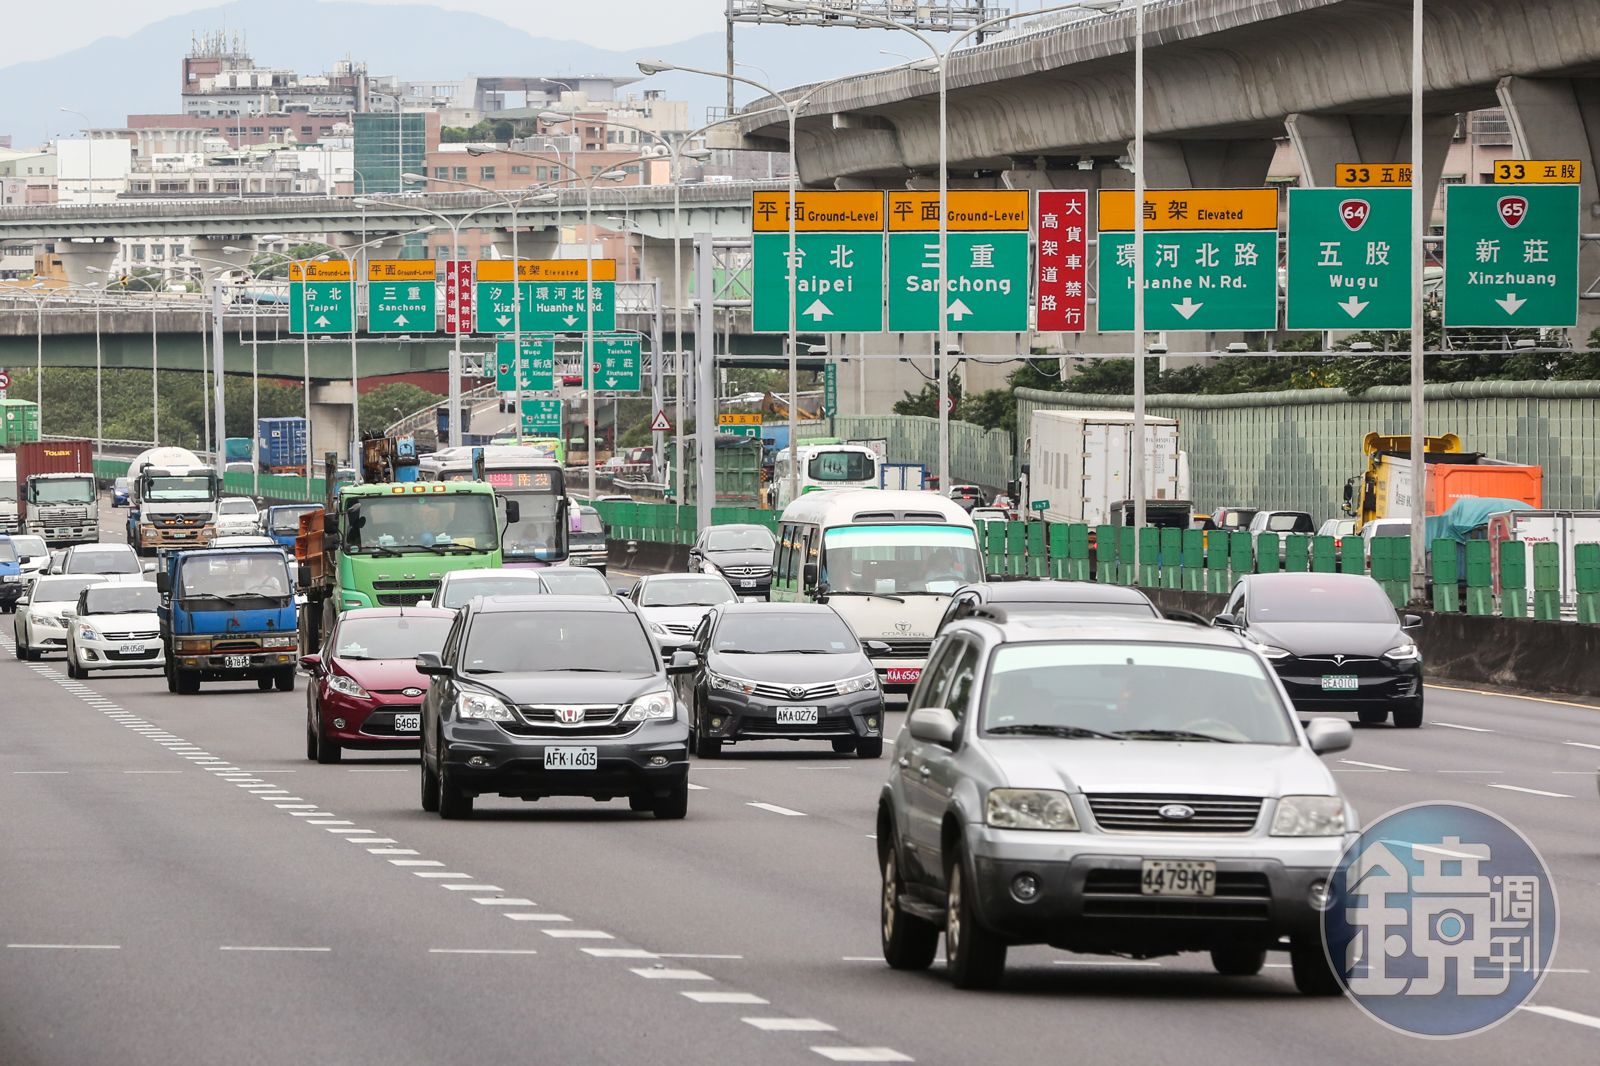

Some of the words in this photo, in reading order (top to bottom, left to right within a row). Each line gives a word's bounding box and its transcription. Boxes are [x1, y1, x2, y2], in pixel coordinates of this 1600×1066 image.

[1345, 168, 1370, 183] 33
[1380, 168, 1412, 183] 五股
[1500, 164, 1526, 180] 33
[1543, 164, 1575, 180] 五股
[757, 201, 805, 221] 平面
[808, 211, 878, 222] Ground-Level
[894, 201, 940, 221] 平面
[947, 210, 1024, 221] Ground-Level
[1143, 200, 1188, 220] 高架
[1197, 208, 1244, 221] Elevated
[1343, 204, 1365, 220] 64
[1502, 201, 1523, 216] 65
[783, 244, 853, 268] 台北
[921, 243, 995, 268] 三重
[1116, 243, 1259, 268] 環河北路
[1317, 241, 1390, 267] 五股
[1475, 239, 1549, 263] 新莊
[1041, 213, 1058, 311] 高架道路
[1065, 199, 1082, 324] 大貨車禁行
[292, 264, 317, 276] 平面
[371, 264, 396, 276] 平面
[906, 275, 1011, 295] Sanchong
[1199, 276, 1216, 289] N.
[1220, 276, 1247, 289] Rd.
[1329, 274, 1378, 290] Wugu
[1467, 271, 1556, 288] Xinzhuang
[305, 287, 342, 301] 台北
[383, 286, 421, 300] 三重
[536, 286, 603, 300] 環河北路
[309, 304, 338, 312] Taipei
[378, 304, 427, 312] Sanchong
[536, 303, 573, 312] Huanhe
[576, 303, 586, 312] N.
[721, 415, 734, 423] 33
